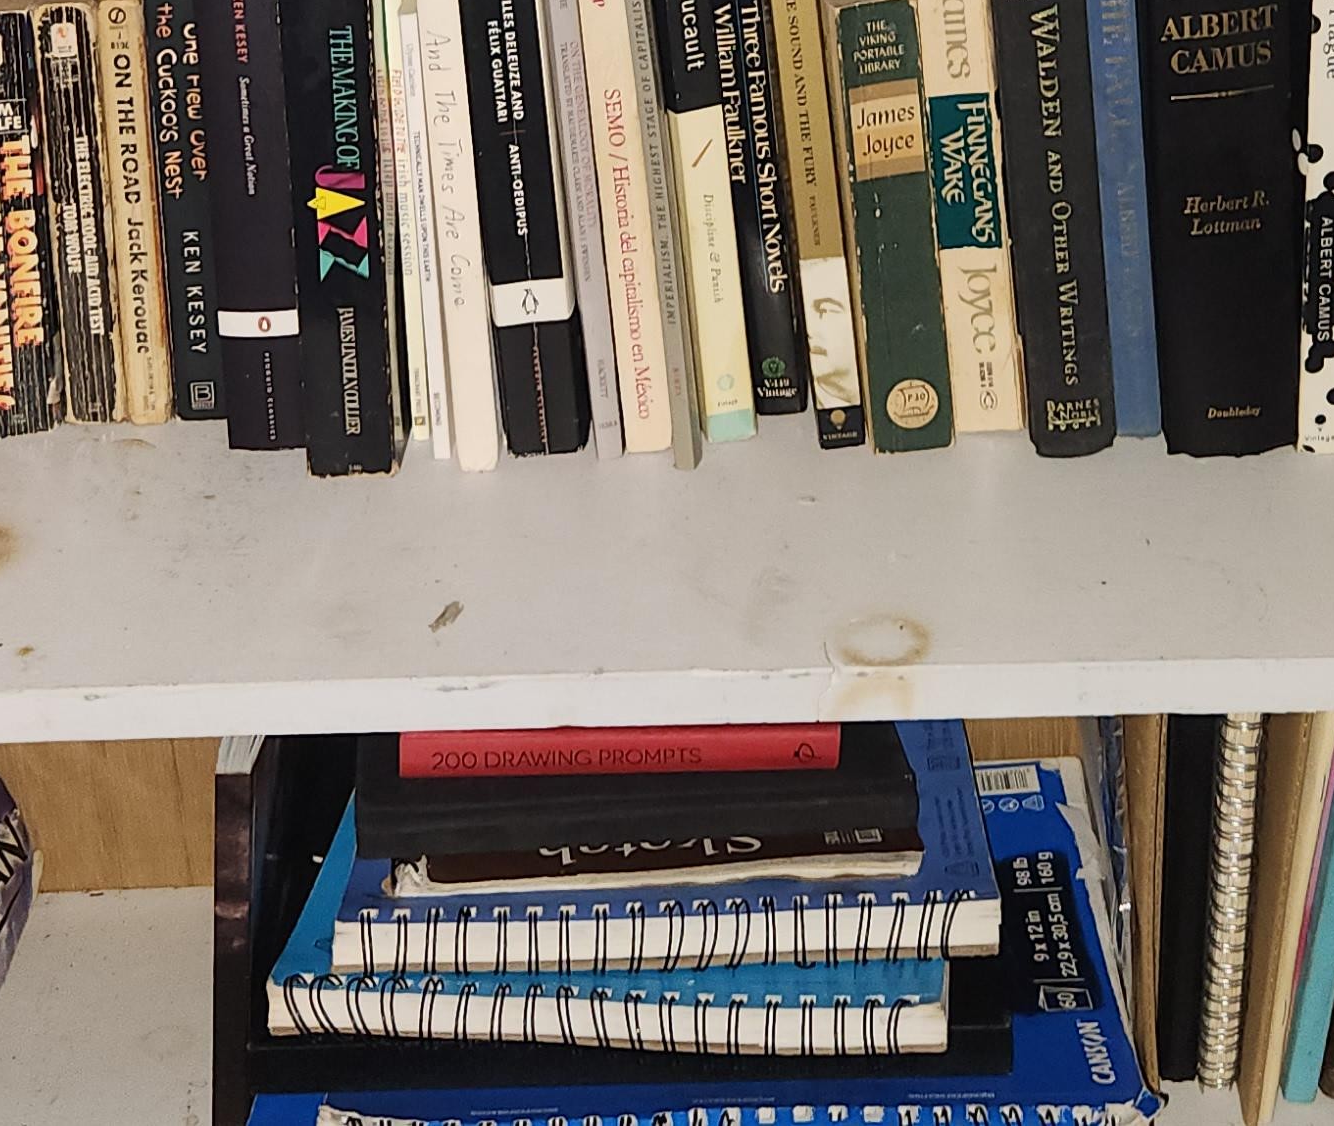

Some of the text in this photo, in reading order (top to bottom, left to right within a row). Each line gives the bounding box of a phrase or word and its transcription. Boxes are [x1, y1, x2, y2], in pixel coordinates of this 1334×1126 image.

[858, 31, 897, 46] VIKING
[867, 20, 889, 32] THE
[1161, 4, 1277, 41] ALBERT
[853, 45, 905, 62] PORTABLE
[858, 59, 902, 75] LIBRARY
[1169, 41, 1273, 75] CAMUS
[487, 19, 508, 123] FÉLIX GUATTARI
[713, 4, 747, 185] William Faulkner
[113, 54, 141, 205] ON THE ROAD
[857, 103, 916, 130] James
[862, 132, 915, 158] Joyce
[508, 143, 528, 236] ANTI-OEDIPUS
[1029, 3, 1080, 387] WALDEN AND OTHER WRITINGS
[1183, 190, 1269, 215] Herbert R.
[1190, 216, 1263, 236] Lottman
[125, 217, 150, 354] Jack Kerouac
[183, 230, 208, 355] KEN KESEY
[1317, 217, 1333, 343] ALBERT CAMUS
[1207, 405, 1261, 419] Doubleday
[431, 747, 702, 772] 200 DRAWING PROMPTS
[1077, 1019, 1116, 1086] CANSON
